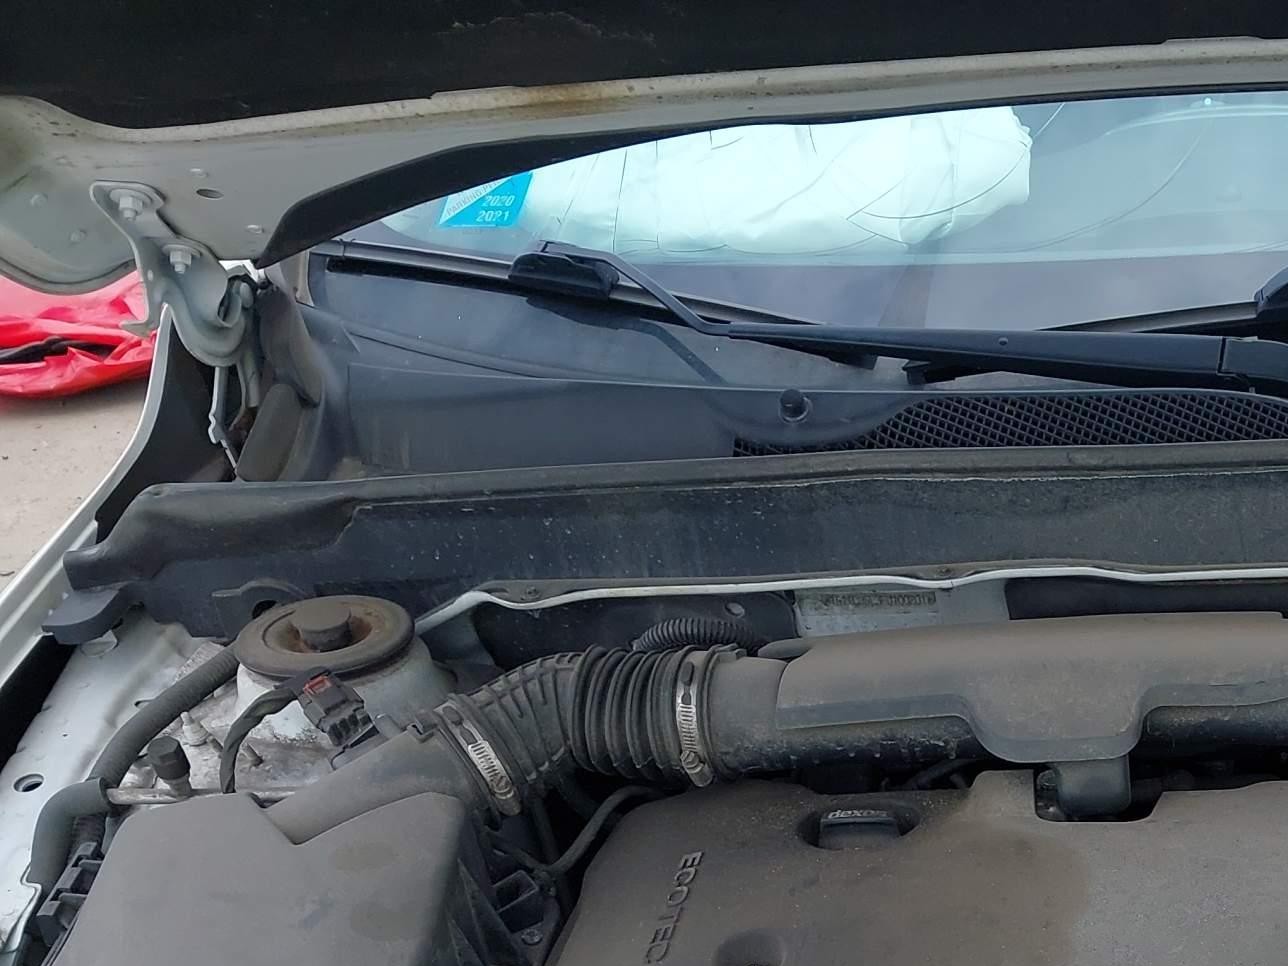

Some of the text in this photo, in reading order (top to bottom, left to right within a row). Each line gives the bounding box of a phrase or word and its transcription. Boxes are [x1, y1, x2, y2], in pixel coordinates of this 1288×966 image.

[481, 195, 515, 207] 2020
[476, 210, 510, 222] 2021
[827, 809, 889, 818] dexos
[645, 851, 704, 964] ECOTEC
